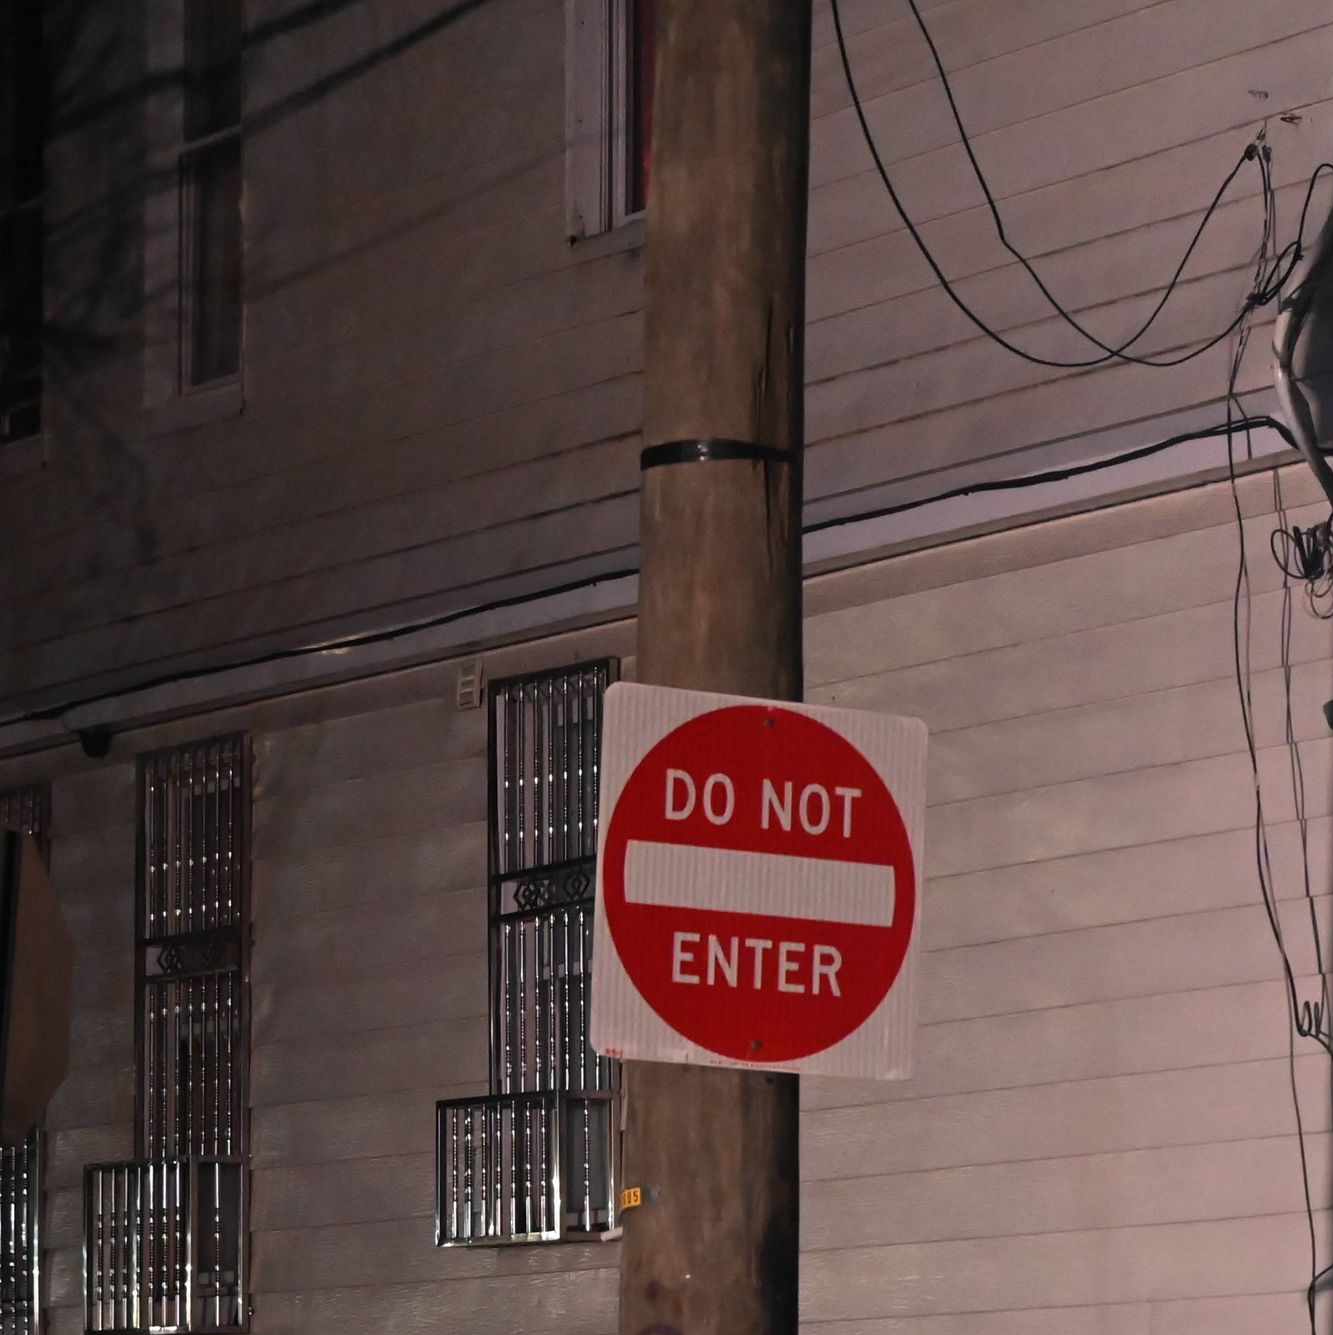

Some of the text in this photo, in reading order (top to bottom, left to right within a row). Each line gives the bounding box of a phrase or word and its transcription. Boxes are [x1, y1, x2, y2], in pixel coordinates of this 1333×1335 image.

[664, 767, 863, 839] DO NOT
[671, 930, 843, 998] ENTER
